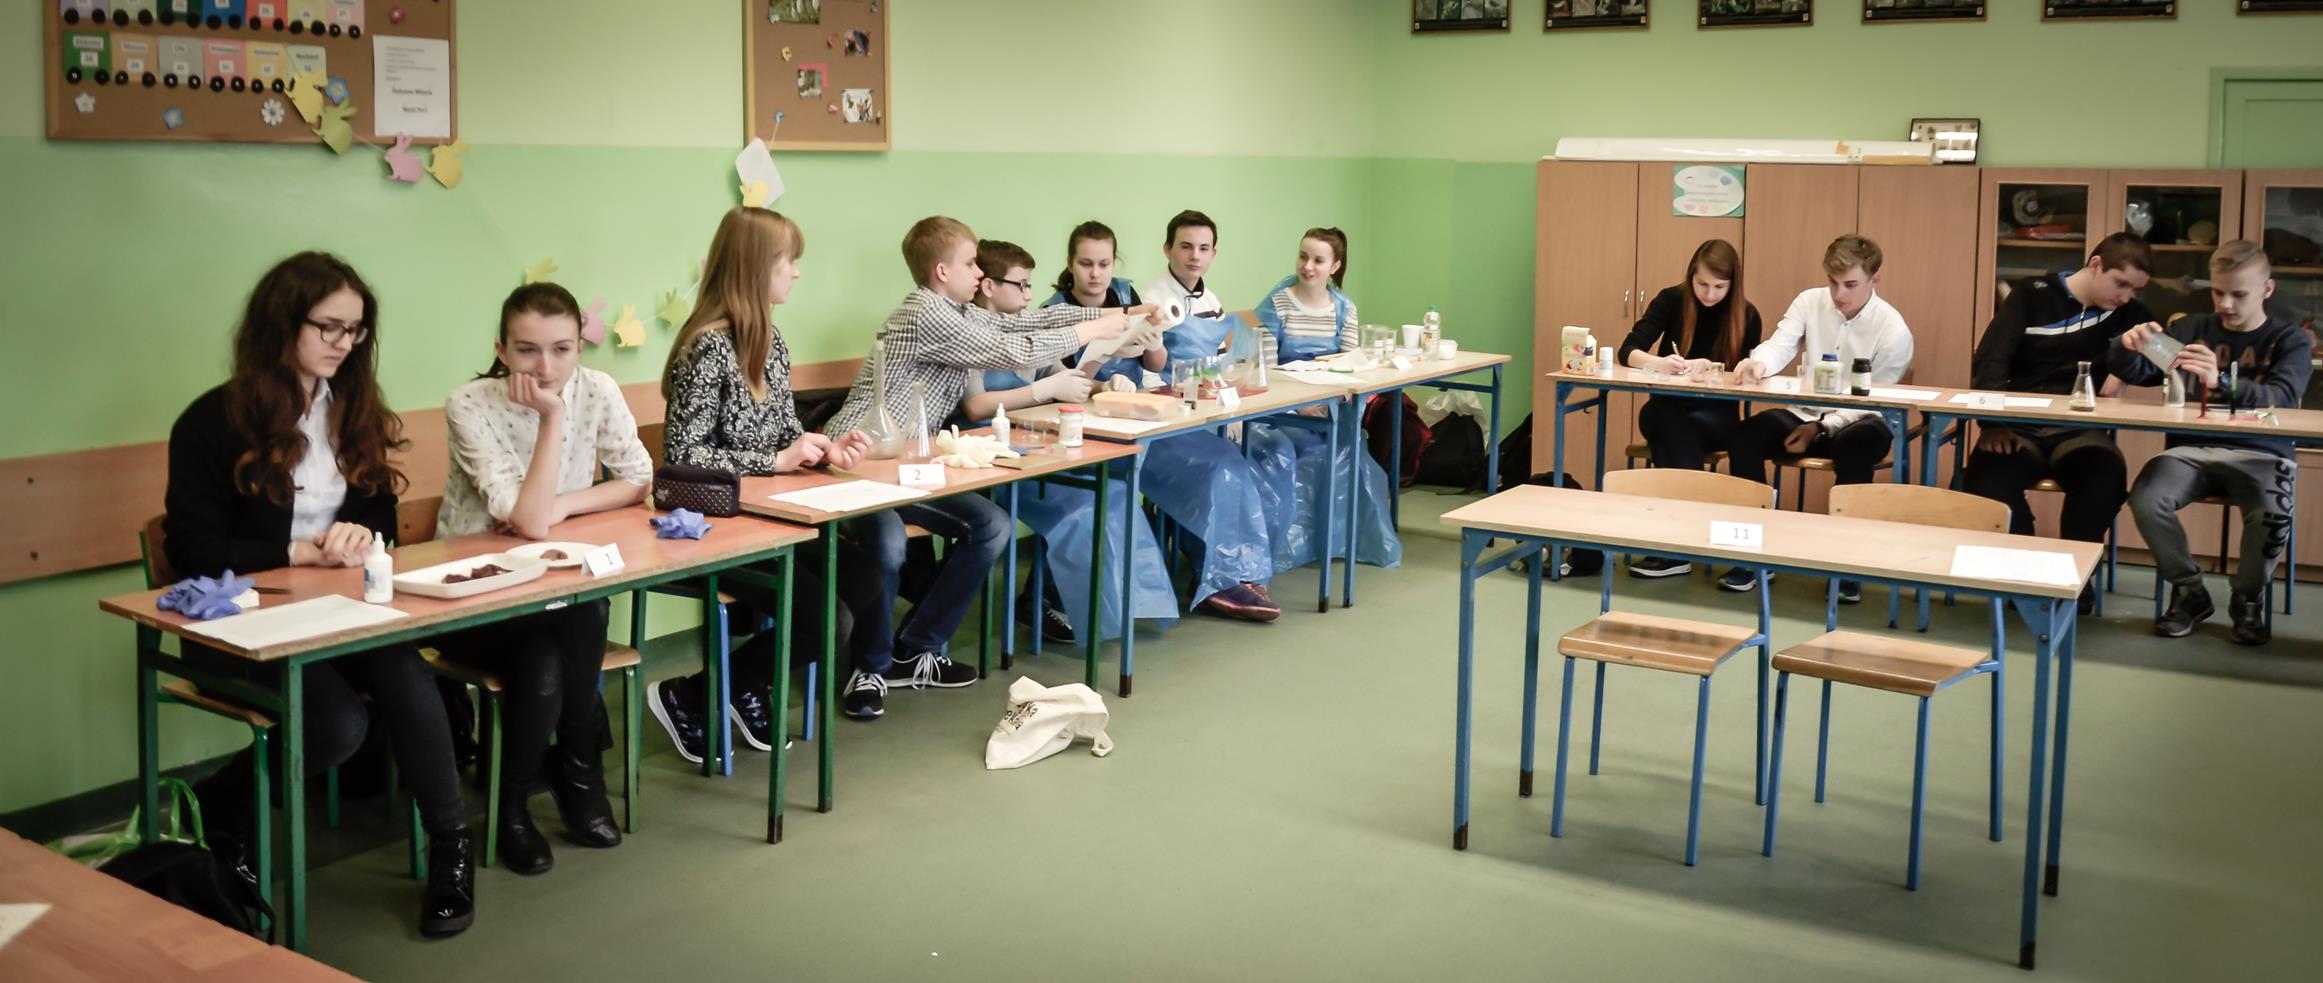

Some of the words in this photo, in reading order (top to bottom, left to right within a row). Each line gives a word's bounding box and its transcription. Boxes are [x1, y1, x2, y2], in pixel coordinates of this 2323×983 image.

[1785, 380, 1792, 390] 5
[1979, 395, 1986, 405] 6
[913, 469, 922, 481] 2
[2262, 460, 2295, 559] adidas
[1732, 527, 1750, 540] 11
[604, 552, 615, 566] 1
